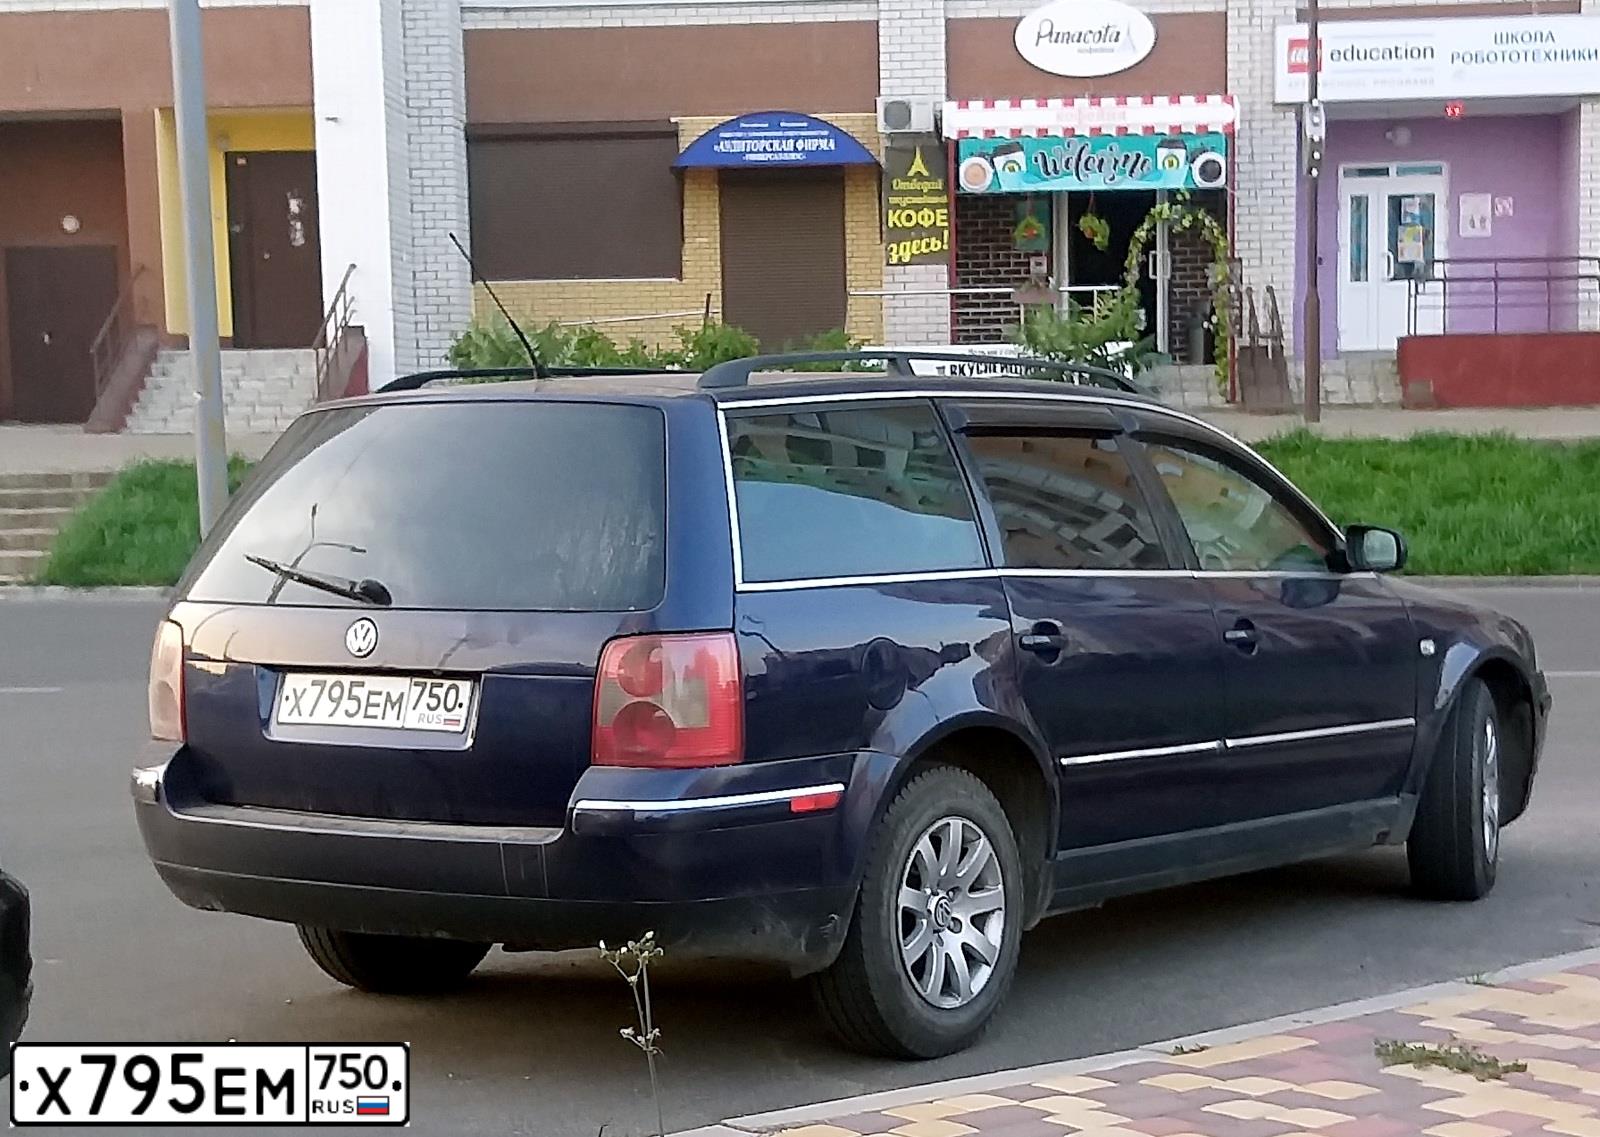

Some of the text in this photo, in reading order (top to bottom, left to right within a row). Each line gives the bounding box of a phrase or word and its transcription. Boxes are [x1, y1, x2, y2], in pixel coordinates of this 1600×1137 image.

[1035, 18, 1121, 47] Panacota
[1493, 30, 1556, 45] ШКОЛА
[1330, 42, 1435, 62] education
[1451, 48, 1598, 65] РОБОТОТЕХНИКИ
[795, 138, 836, 152] ФИРМА
[887, 207, 949, 228] КОФЕ
[887, 229, 949, 264] здесь!
[288, 679, 460, 721] Х795ЕМ 750
[418, 714, 442, 724] RUS
